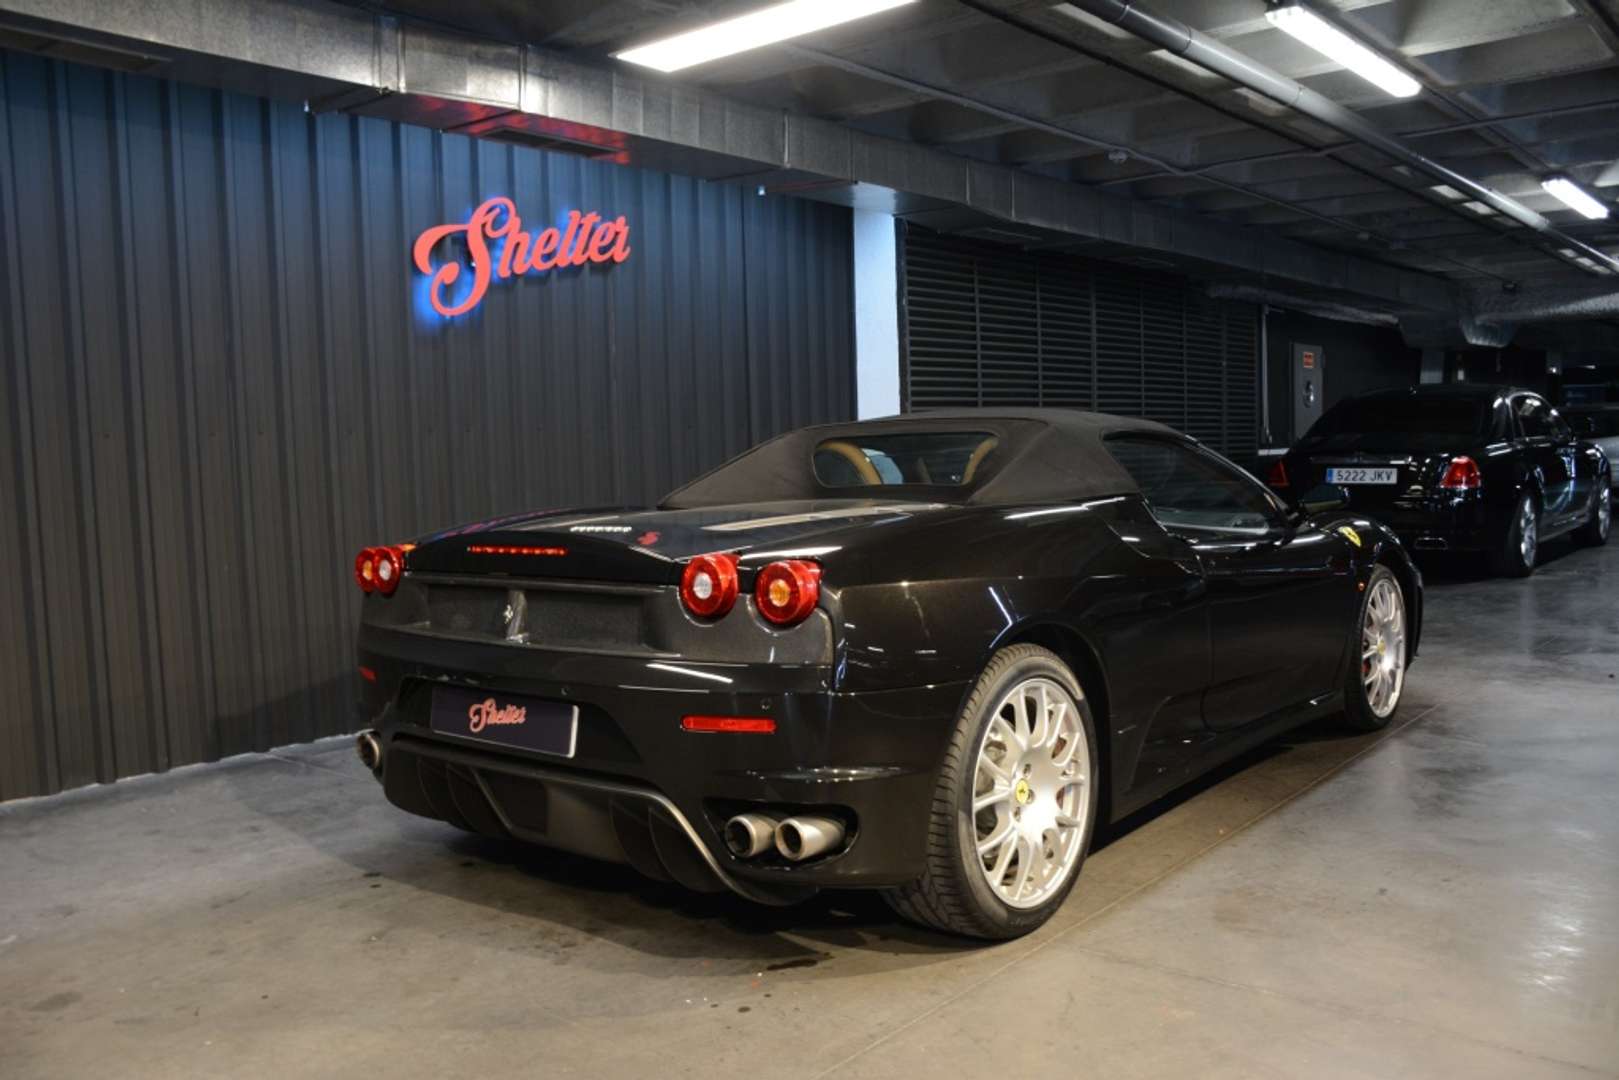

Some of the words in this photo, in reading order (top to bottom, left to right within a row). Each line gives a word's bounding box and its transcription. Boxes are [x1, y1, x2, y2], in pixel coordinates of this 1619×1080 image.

[413, 196, 630, 316] Shelter
[1336, 469, 1367, 482] 5222
[1369, 469, 1393, 482] JKV
[469, 698, 526, 733] Shelter
